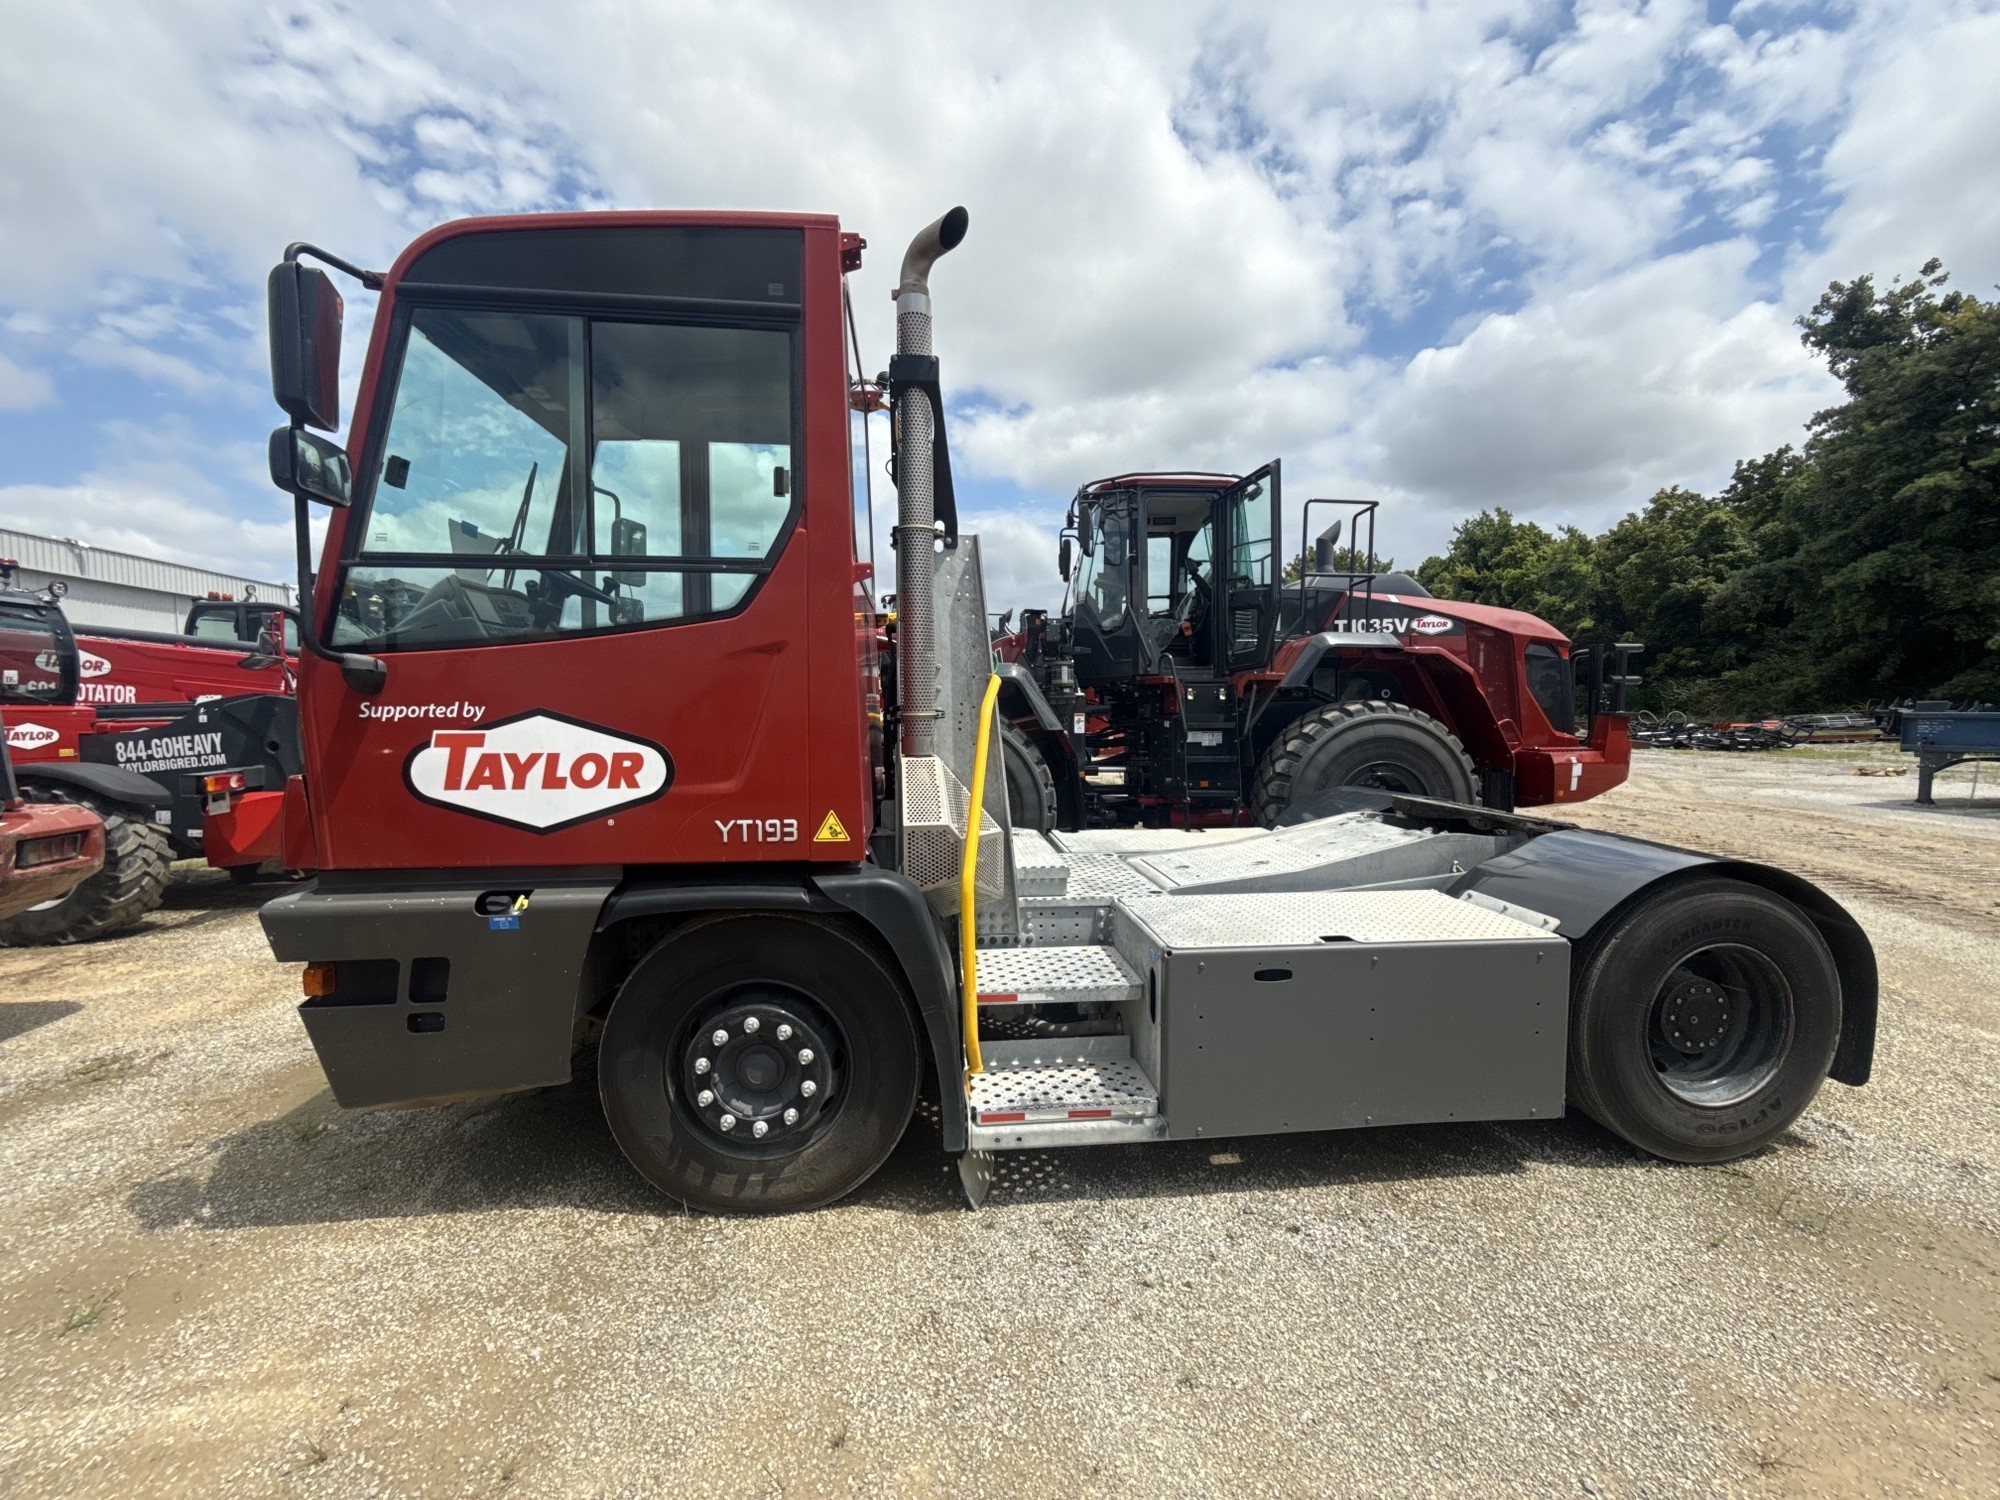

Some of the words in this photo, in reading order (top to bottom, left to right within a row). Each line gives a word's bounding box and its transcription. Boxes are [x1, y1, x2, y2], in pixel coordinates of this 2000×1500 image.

[1416, 618, 1448, 628] TAYLOR
[76, 683, 136, 704] OTATOR
[358, 701, 459, 722] Supported
[462, 701, 486, 722] by
[4, 727, 54, 741] TAYLOR
[115, 732, 222, 763] 844-GOHEAVY
[433, 732, 645, 791] TAYLOR
[714, 818, 798, 843] YT193
